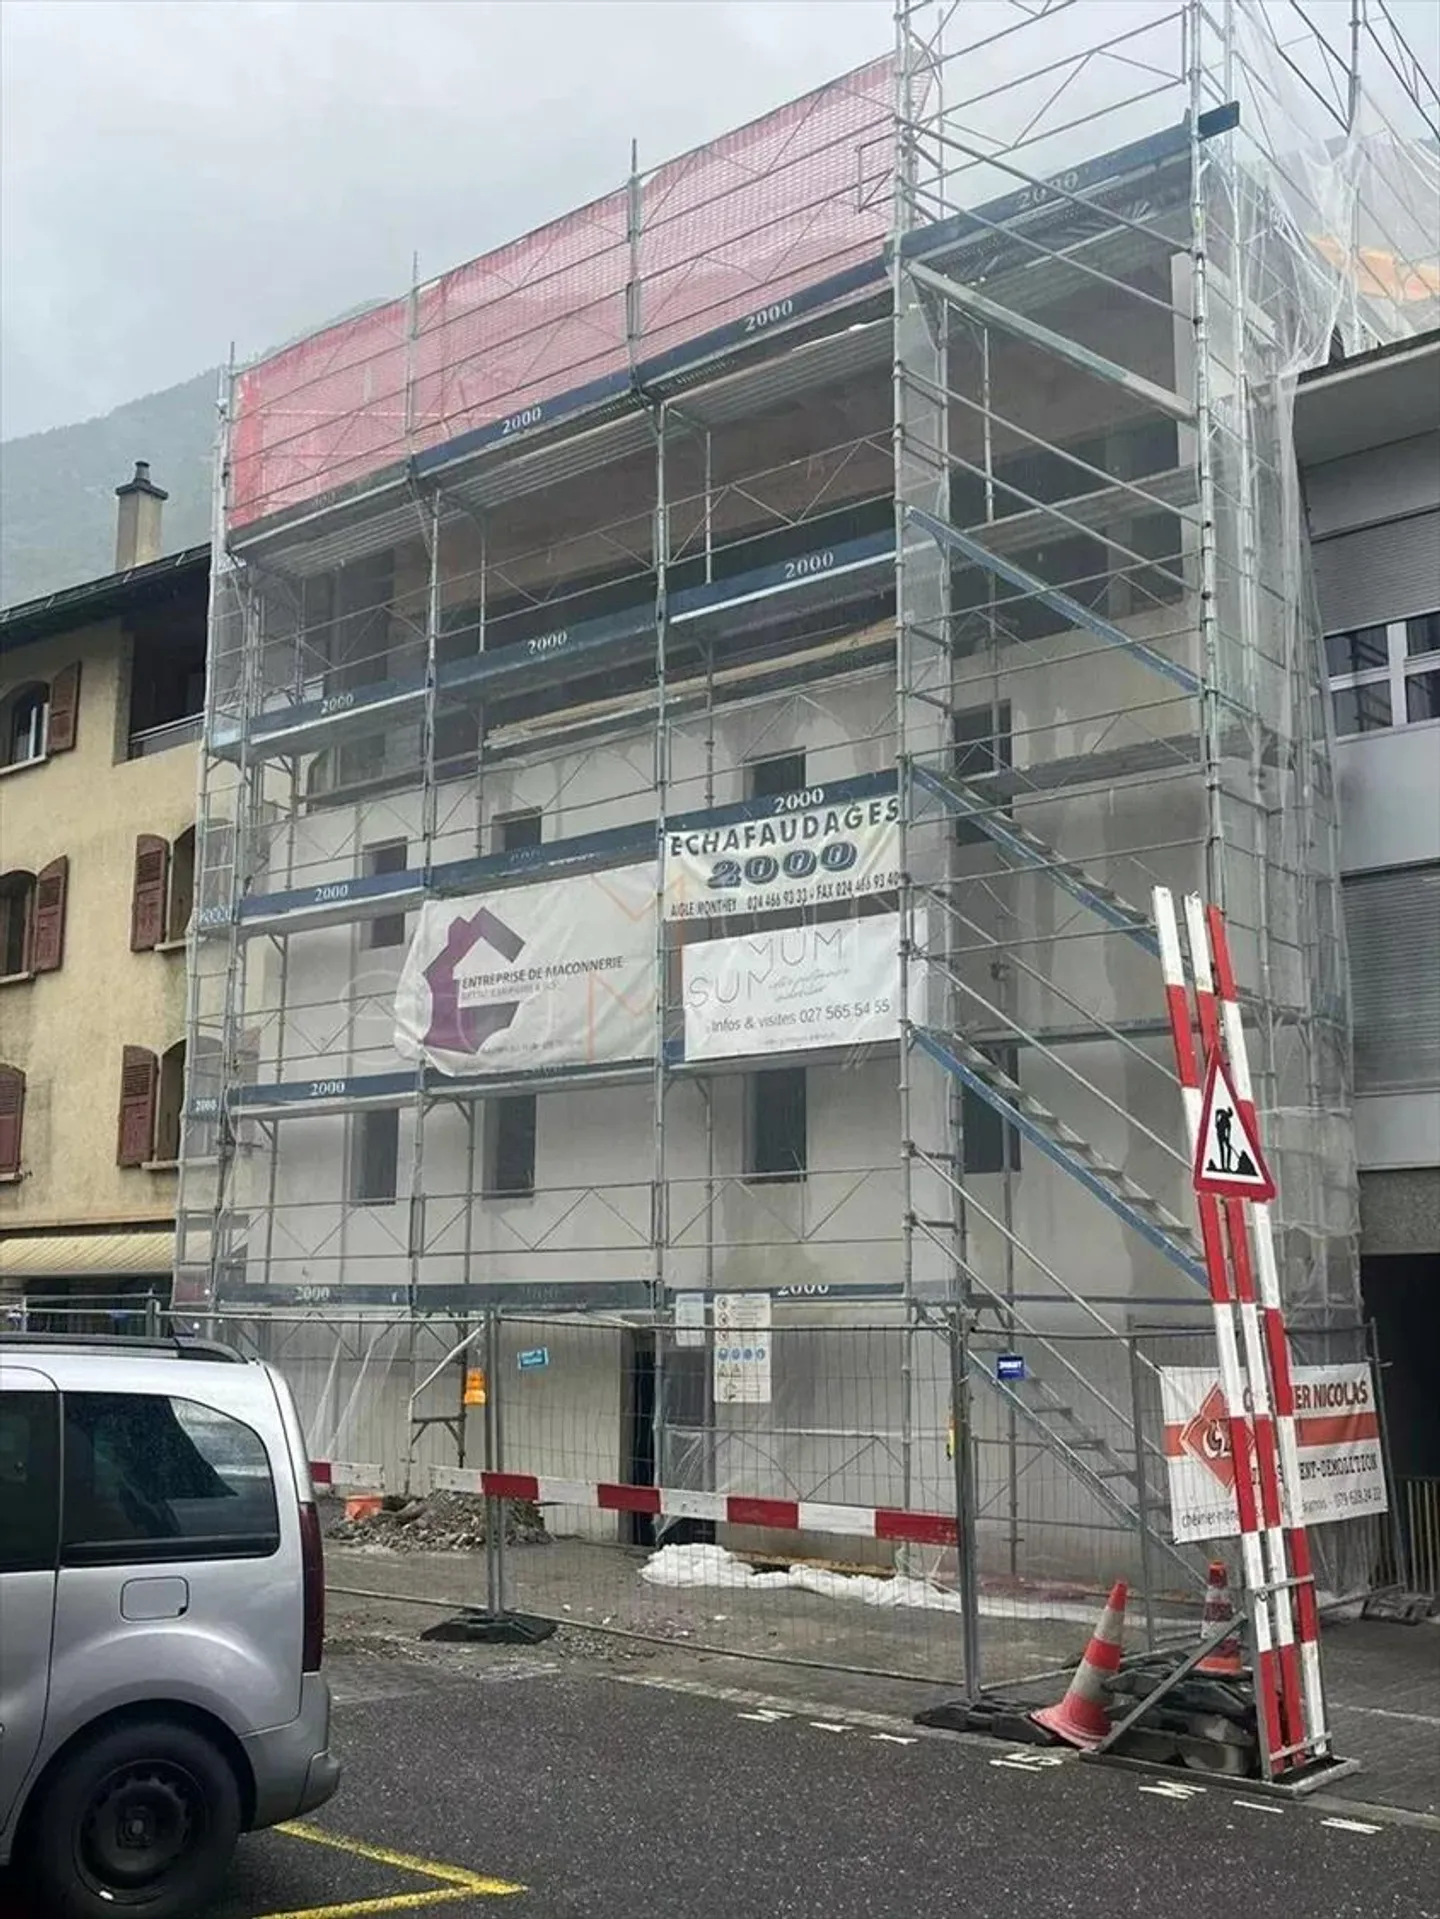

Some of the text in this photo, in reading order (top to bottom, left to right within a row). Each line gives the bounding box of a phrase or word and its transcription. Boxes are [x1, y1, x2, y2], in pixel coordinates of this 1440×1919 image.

[744, 299, 793, 332] 2000
[502, 406, 542, 435] 2000
[784, 551, 834, 579] 2000
[320, 694, 355, 714] 2000
[774, 787, 825, 813] 2000
[670, 798, 899, 856] ECHAFAUDAGES
[707, 842, 858, 889] 2000
[314, 884, 348, 902] 2000
[816, 883, 833, 899] FAX
[462, 969, 525, 989] ENTREPRISE
[528, 967, 542, 981] DE
[711, 999, 890, 1032] Infos & visites 027 565 54 55
[310, 1080, 345, 1097] 2000
[1313, 1380, 1368, 1409] NICOLAS
